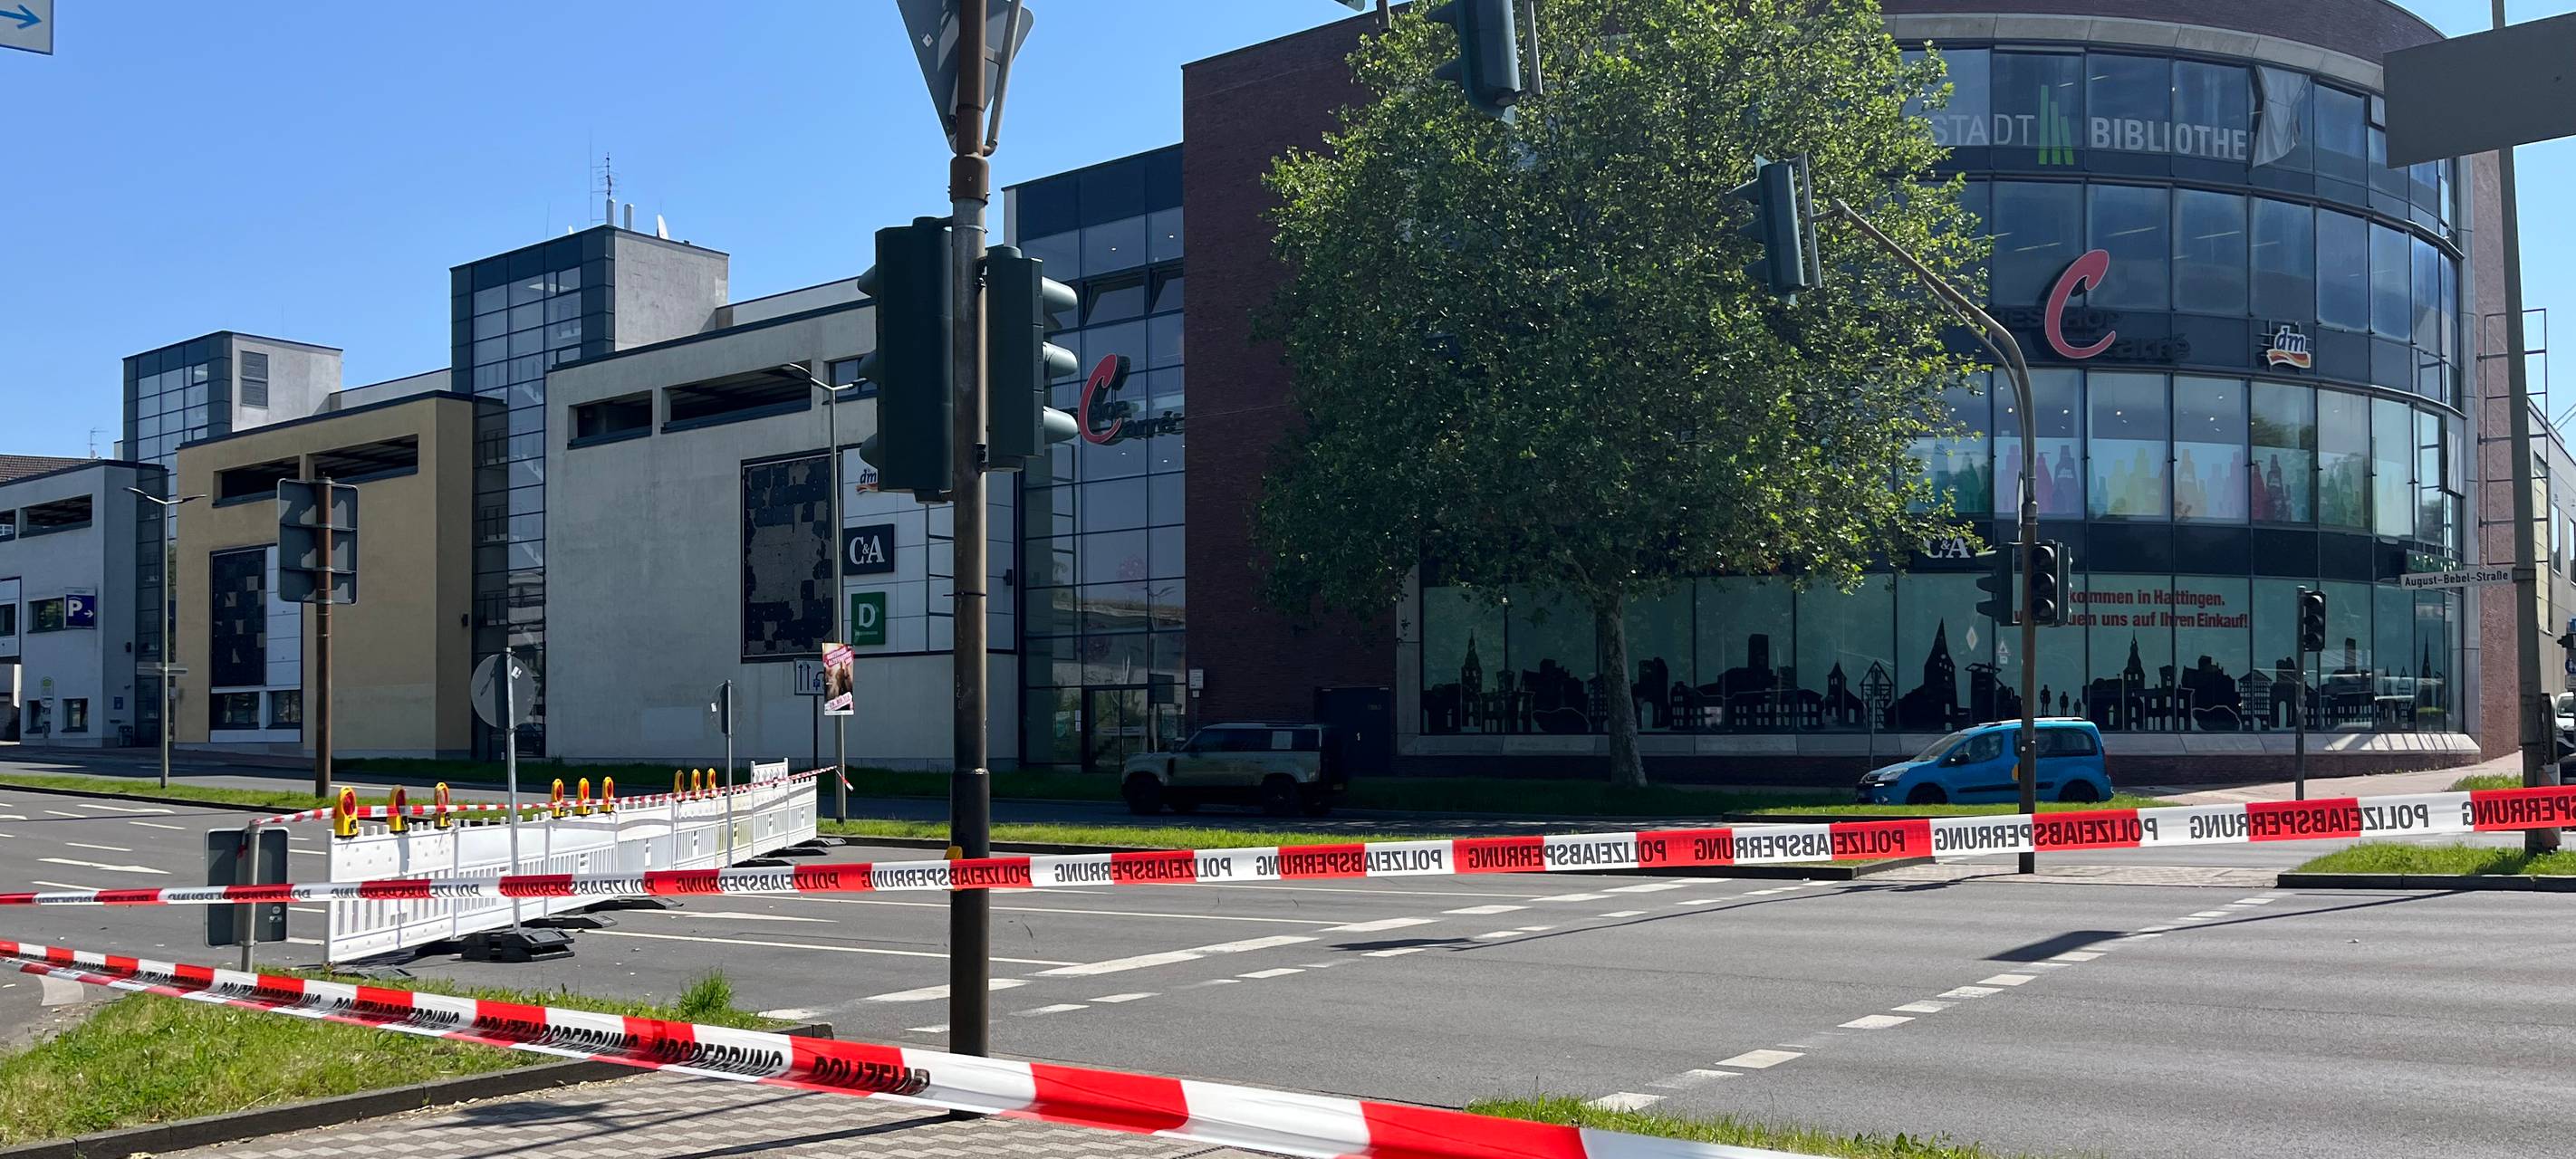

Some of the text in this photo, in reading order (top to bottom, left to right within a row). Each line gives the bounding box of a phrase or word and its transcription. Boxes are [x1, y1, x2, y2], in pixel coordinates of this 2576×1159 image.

[1930, 114, 2254, 161] STADT BIBLIOTHE
[2275, 327, 2306, 352] dm
[860, 469, 877, 484] dm
[850, 535, 885, 565] C&A
[2405, 570, 2508, 588] August-Bebel-Straße
[68, 599, 82, 617] P
[2069, 589, 2225, 608] kommen in Hattingen.
[858, 603, 876, 627] D
[2101, 613, 2128, 627] uns
[2132, 611, 2157, 627] auf
[2160, 612, 2195, 627] Ihren
[2196, 612, 2248, 628] Einkauf!
